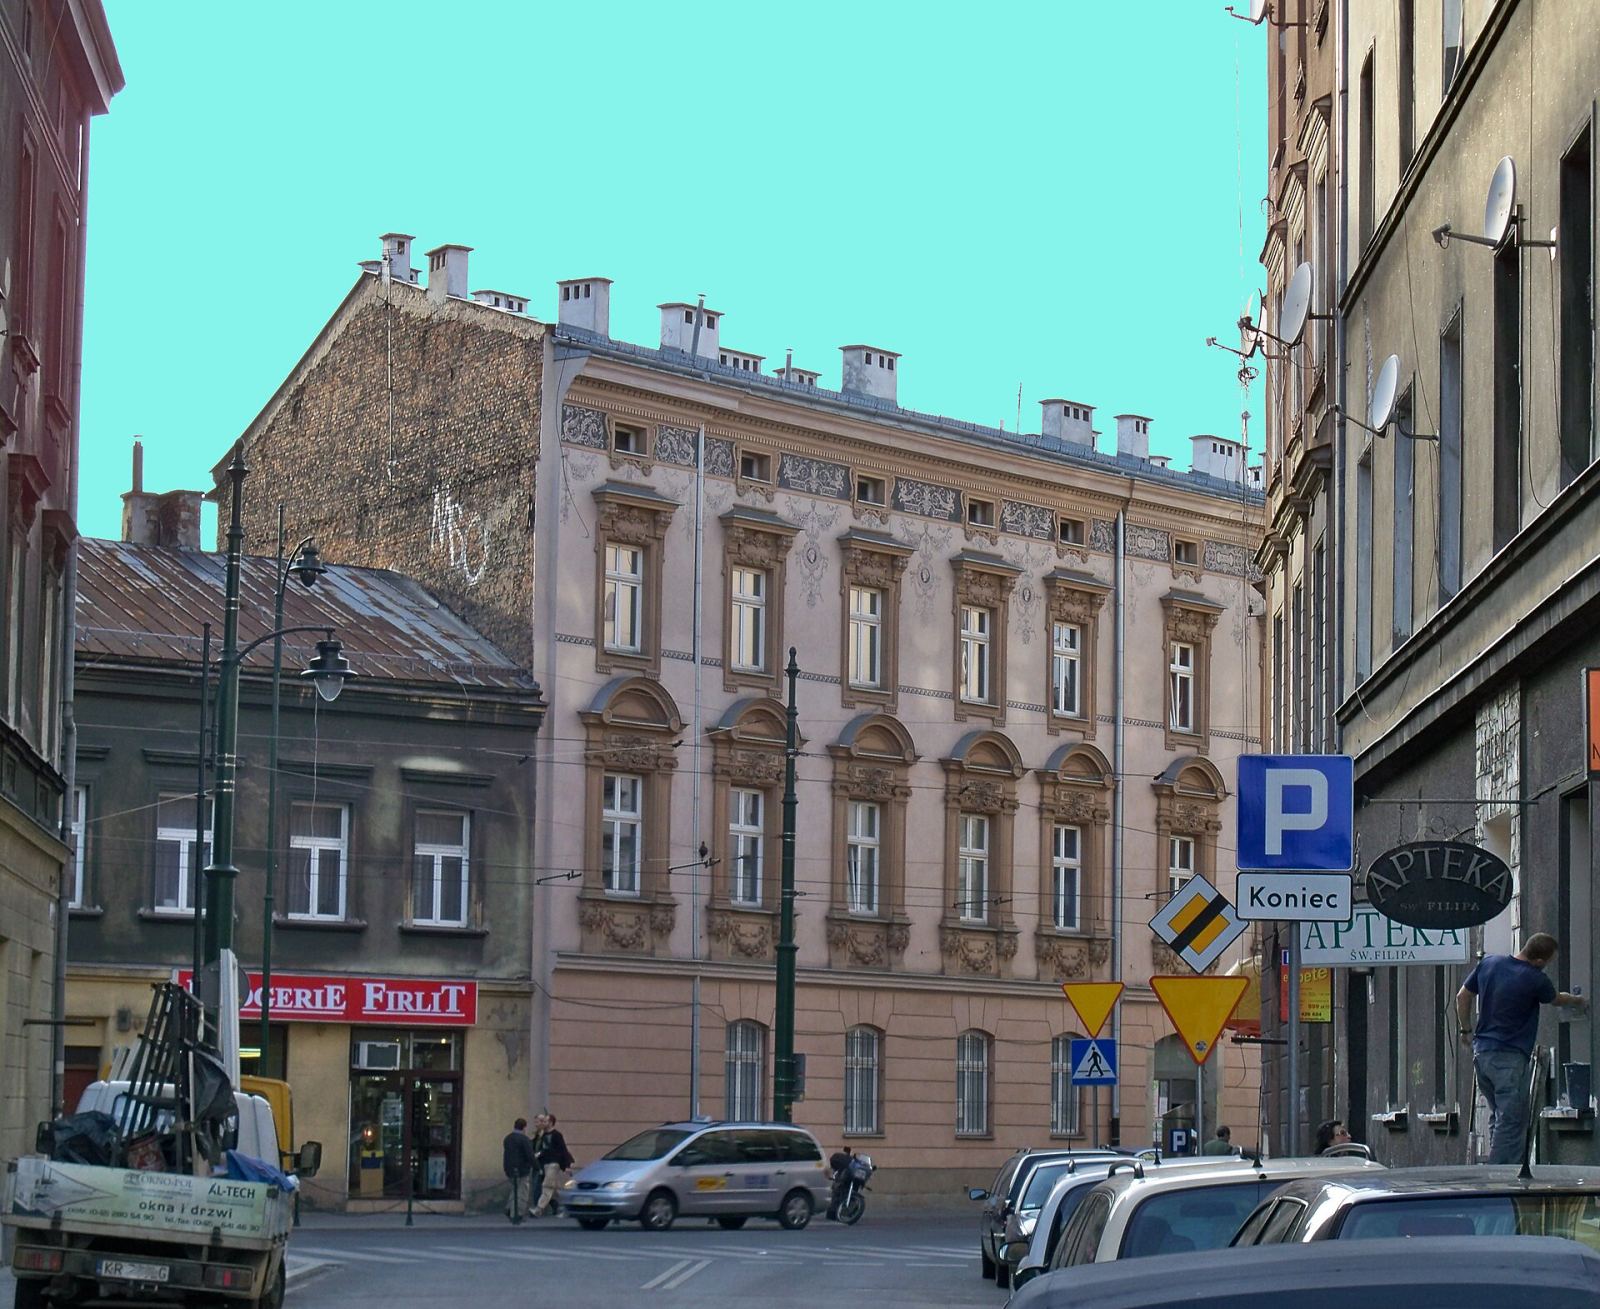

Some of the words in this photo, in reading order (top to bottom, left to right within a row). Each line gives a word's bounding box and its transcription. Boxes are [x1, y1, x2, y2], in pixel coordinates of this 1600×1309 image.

[1265, 769, 1328, 855] P
[1368, 847, 1510, 904] APTEKA
[1250, 886, 1338, 908] Koniec
[1427, 902, 1480, 911] FILIPA
[362, 982, 466, 1013] FIRLIT
[1173, 1131, 1186, 1151] P
[139, 1200, 175, 1213] okna
[181, 1203, 185, 1214] i
[191, 1205, 233, 1219] drzwi
